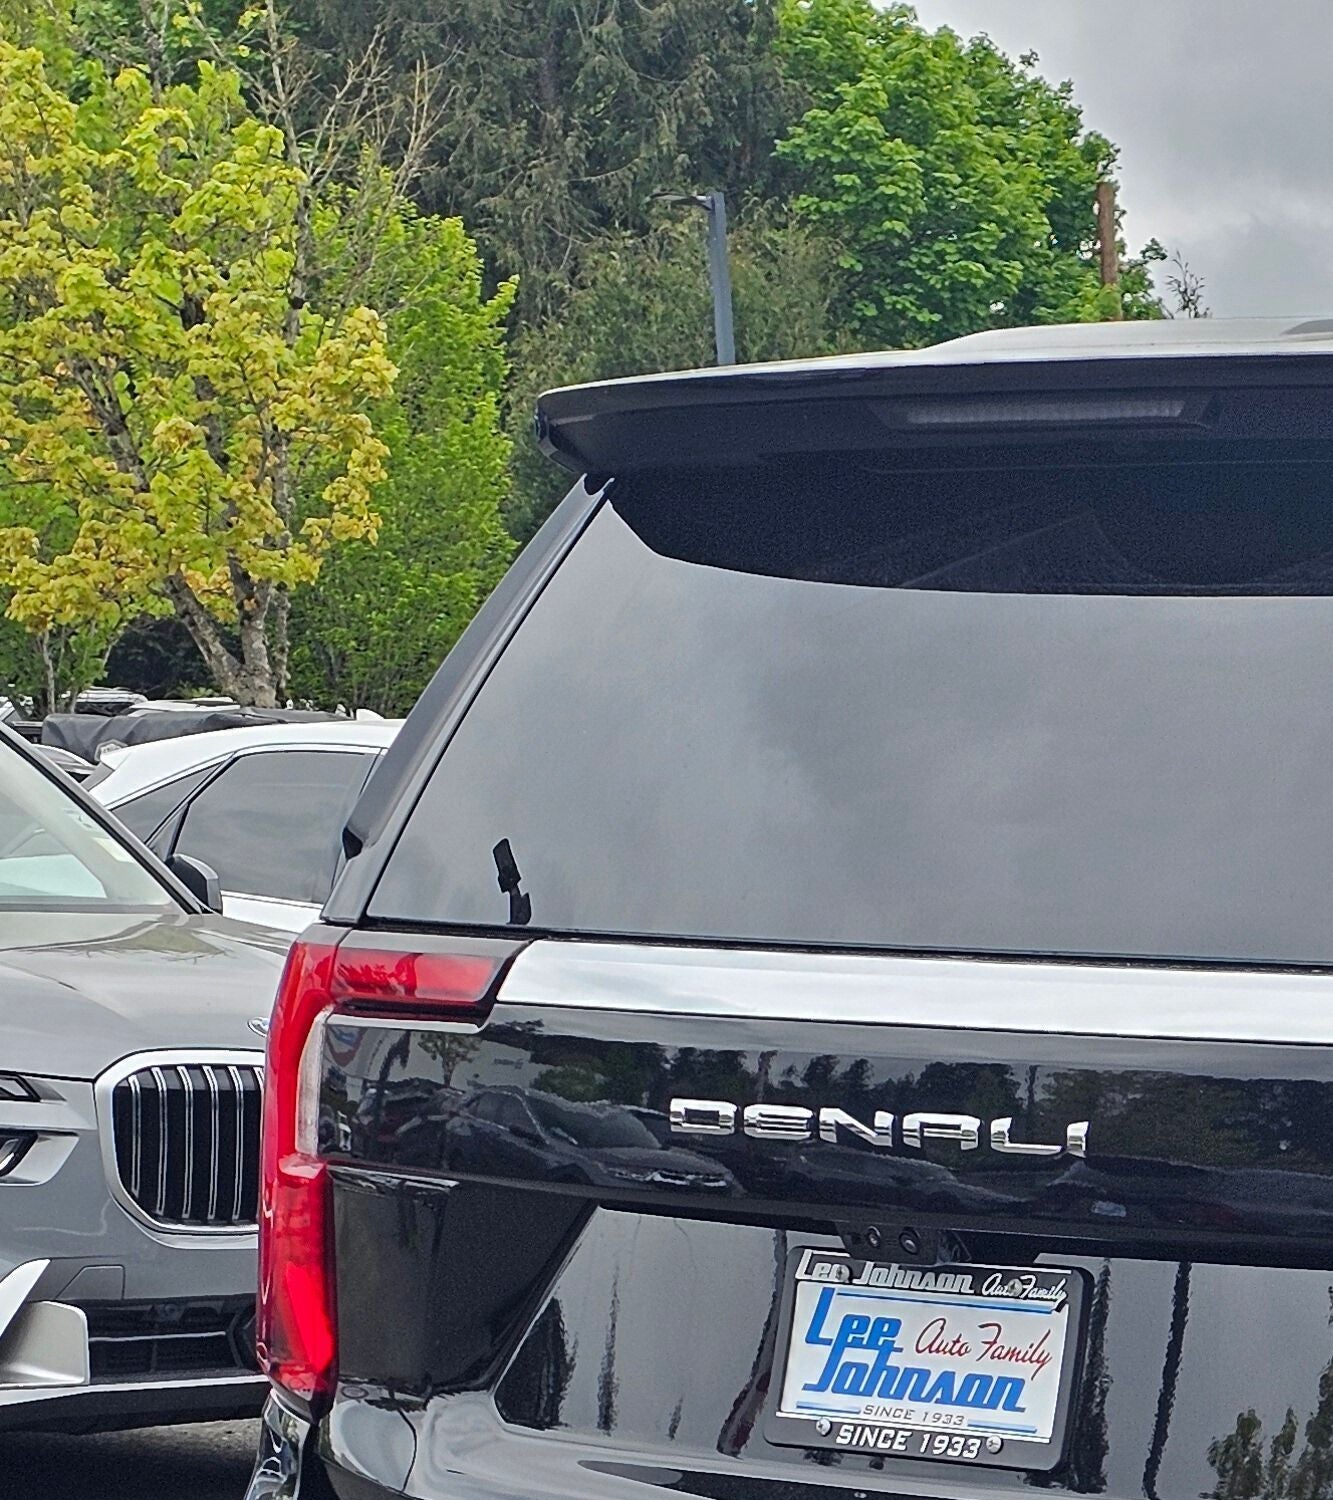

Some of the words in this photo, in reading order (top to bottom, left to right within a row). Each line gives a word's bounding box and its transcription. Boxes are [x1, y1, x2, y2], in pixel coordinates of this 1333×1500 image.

[669, 1098, 1090, 1158] DENALI
[852, 1261, 975, 1294] Johnson
[982, 1273, 1022, 1297] Au
[1019, 1275, 1068, 1311] Family
[805, 1287, 904, 1353] Lee
[915, 1318, 971, 1358] Auto
[976, 1323, 1053, 1381] Family
[802, 1318, 1026, 1413] Johnson
[836, 1424, 912, 1451] SINCE
[920, 1433, 981, 1459] 1933
[863, 1404, 915, 1421] SINCE
[923, 1411, 965, 1426] 1933
